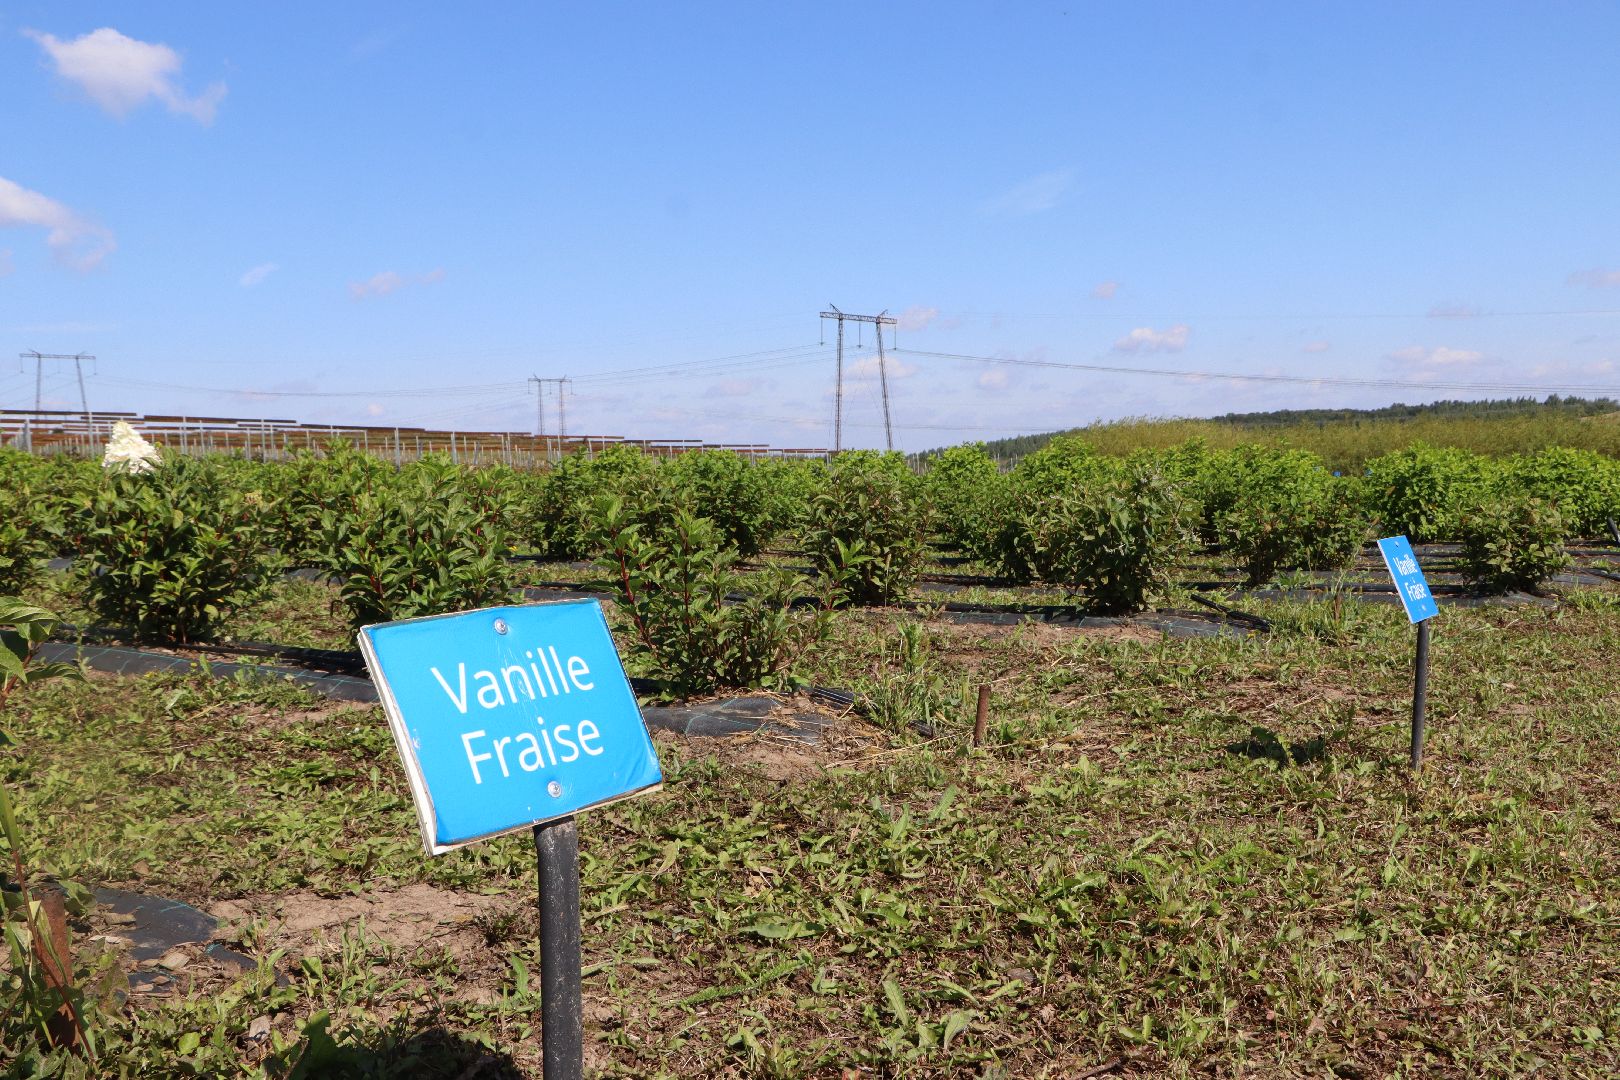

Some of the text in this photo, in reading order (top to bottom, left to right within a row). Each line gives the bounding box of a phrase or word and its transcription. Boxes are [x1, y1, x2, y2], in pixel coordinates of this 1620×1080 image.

[1393, 554, 1418, 576] Vanille
[1404, 578, 1427, 601] Fraise
[430, 645, 594, 714] Vanille
[461, 716, 604, 784] Fraise
